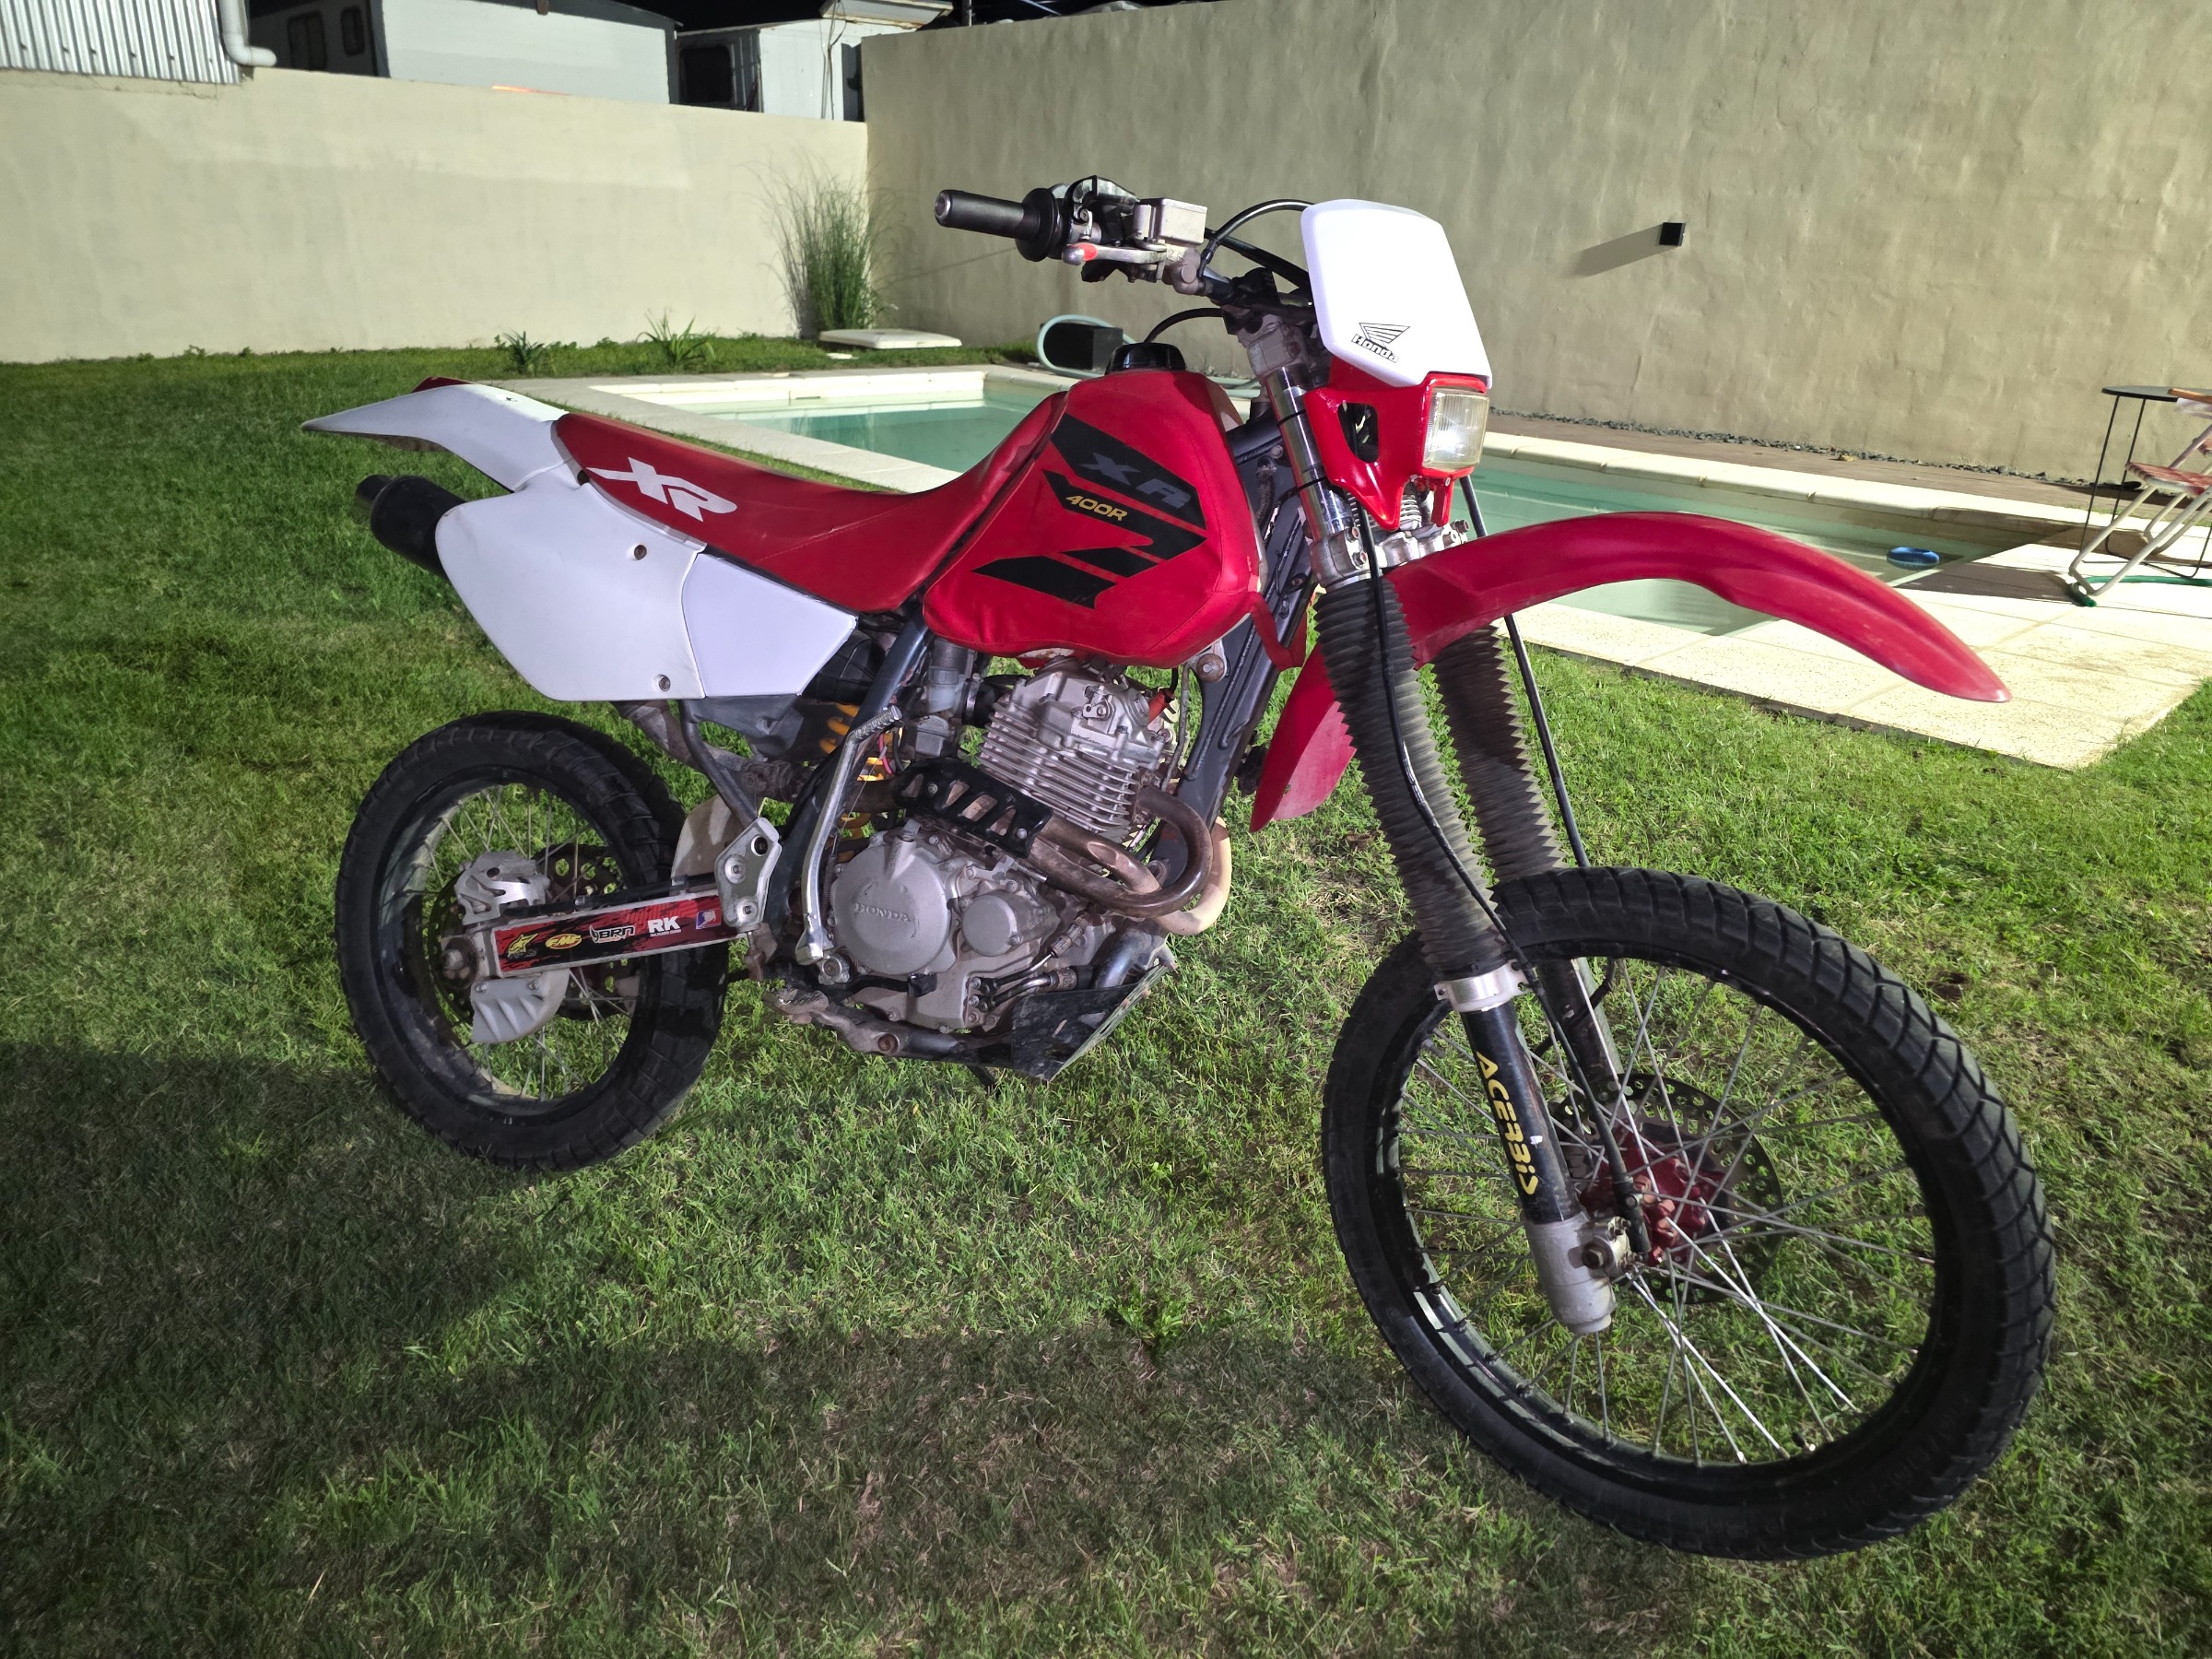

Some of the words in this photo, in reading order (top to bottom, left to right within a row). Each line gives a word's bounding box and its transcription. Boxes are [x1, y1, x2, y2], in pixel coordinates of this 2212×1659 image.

[1351, 334, 1400, 364] Honda
[585, 456, 737, 523] XR
[1079, 452, 1192, 508] XR
[1065, 495, 1128, 522] 400R
[647, 915, 681, 934] RK
[854, 902, 912, 923] HONDA
[546, 934, 582, 948] FMF
